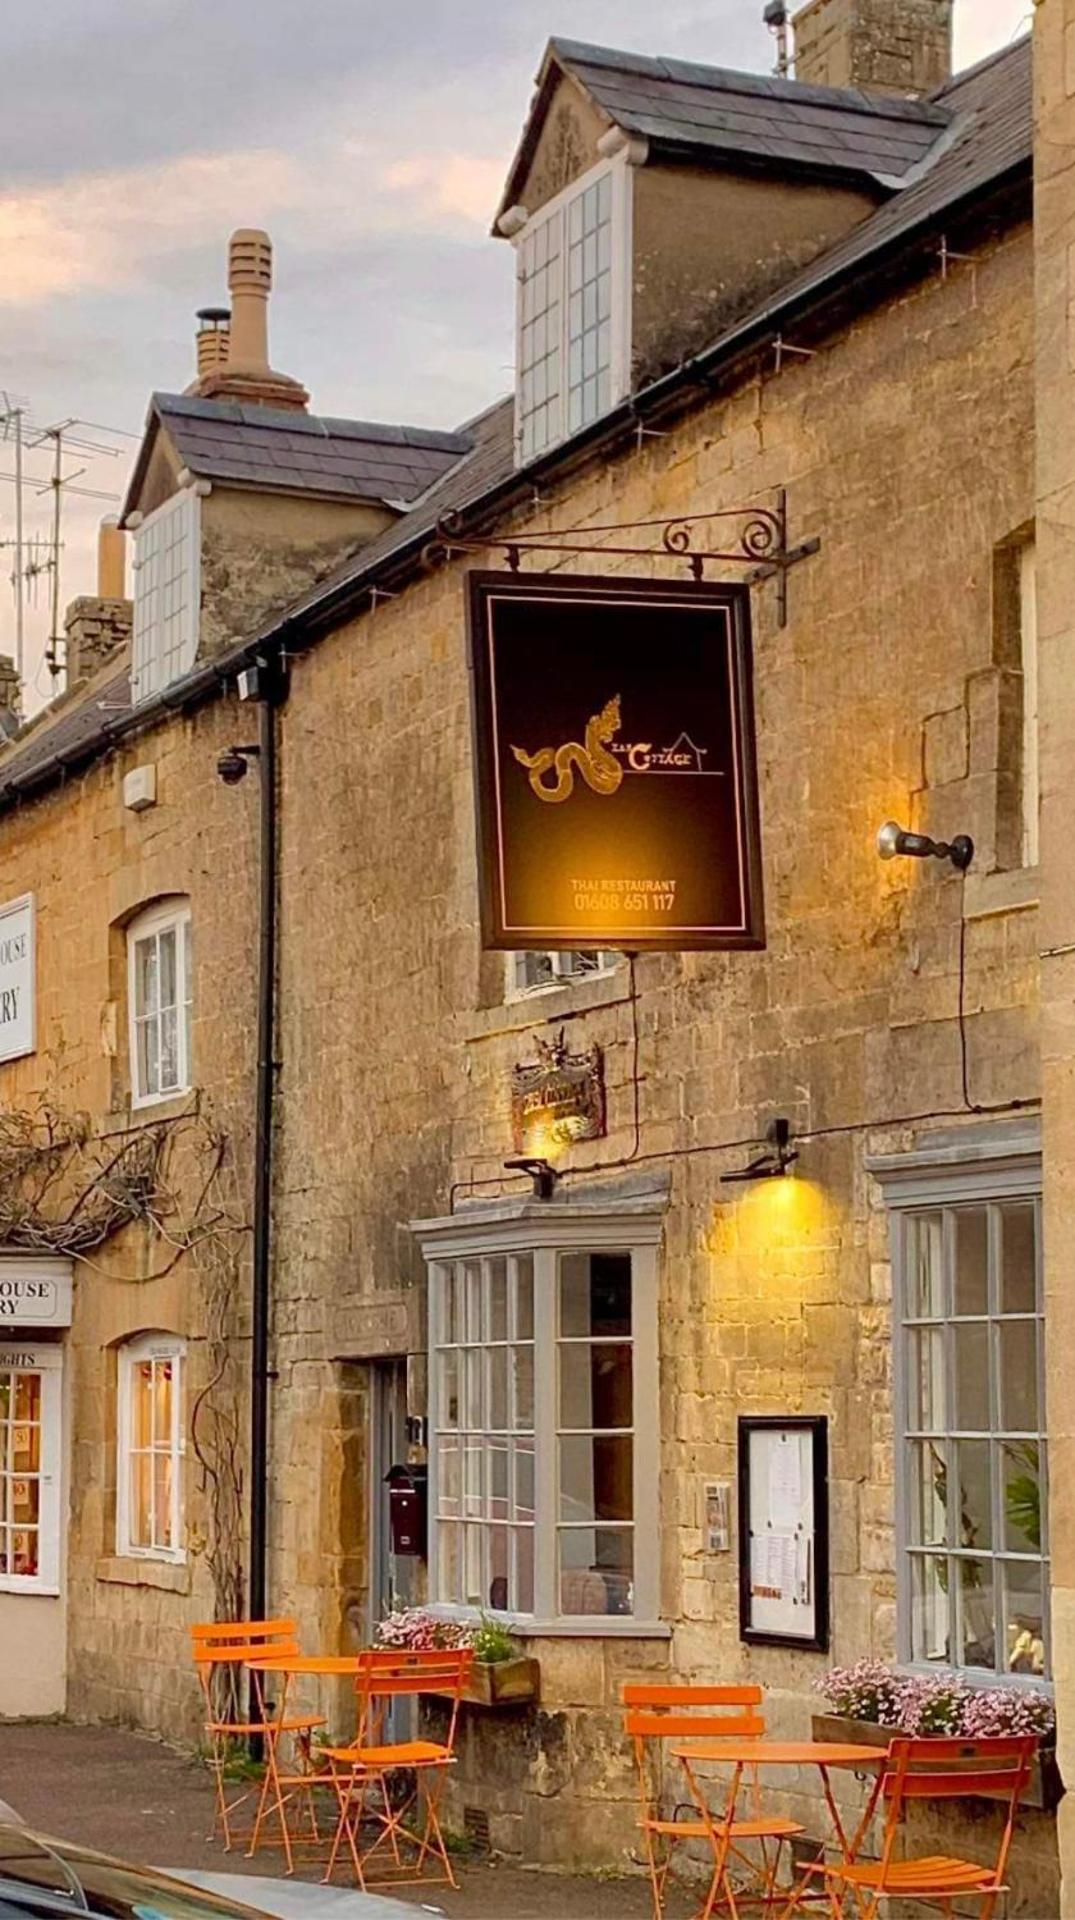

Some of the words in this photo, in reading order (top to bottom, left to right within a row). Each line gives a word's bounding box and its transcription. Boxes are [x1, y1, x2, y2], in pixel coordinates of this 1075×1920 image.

[571, 879, 599, 891] THAI
[601, 879, 677, 893] RESTAURANT
[574, 893, 620, 911] 01608
[623, 893, 649, 911] 651
[652, 893, 675, 911] 117
[0, 985, 20, 1024] RY
